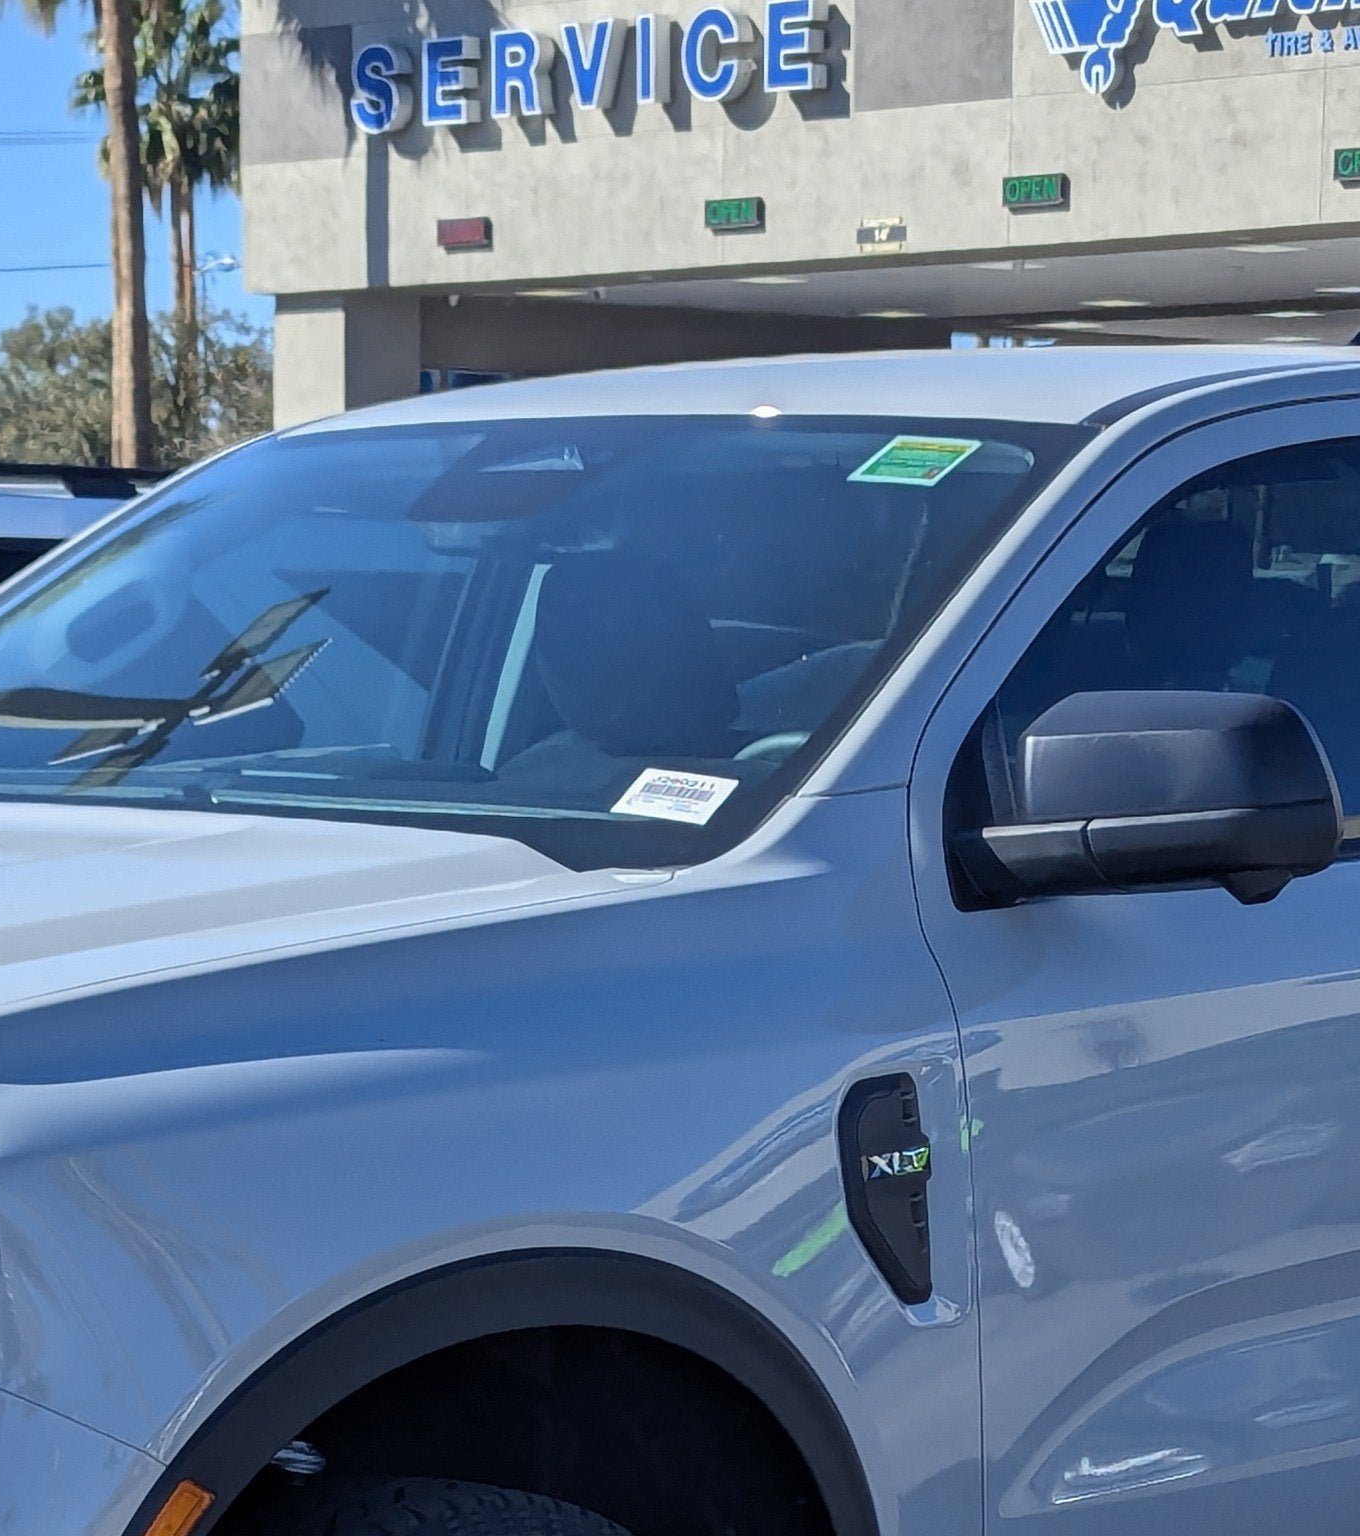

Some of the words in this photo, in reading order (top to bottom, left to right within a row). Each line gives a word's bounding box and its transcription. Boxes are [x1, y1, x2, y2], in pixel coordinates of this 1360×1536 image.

[1267, 31, 1311, 57] TIRE
[1320, 29, 1334, 52] &
[351, 0, 815, 134] SERVICE
[1006, 178, 1058, 201] OPEN
[707, 201, 754, 224] OPEN
[868, 1147, 930, 1179] XLT
